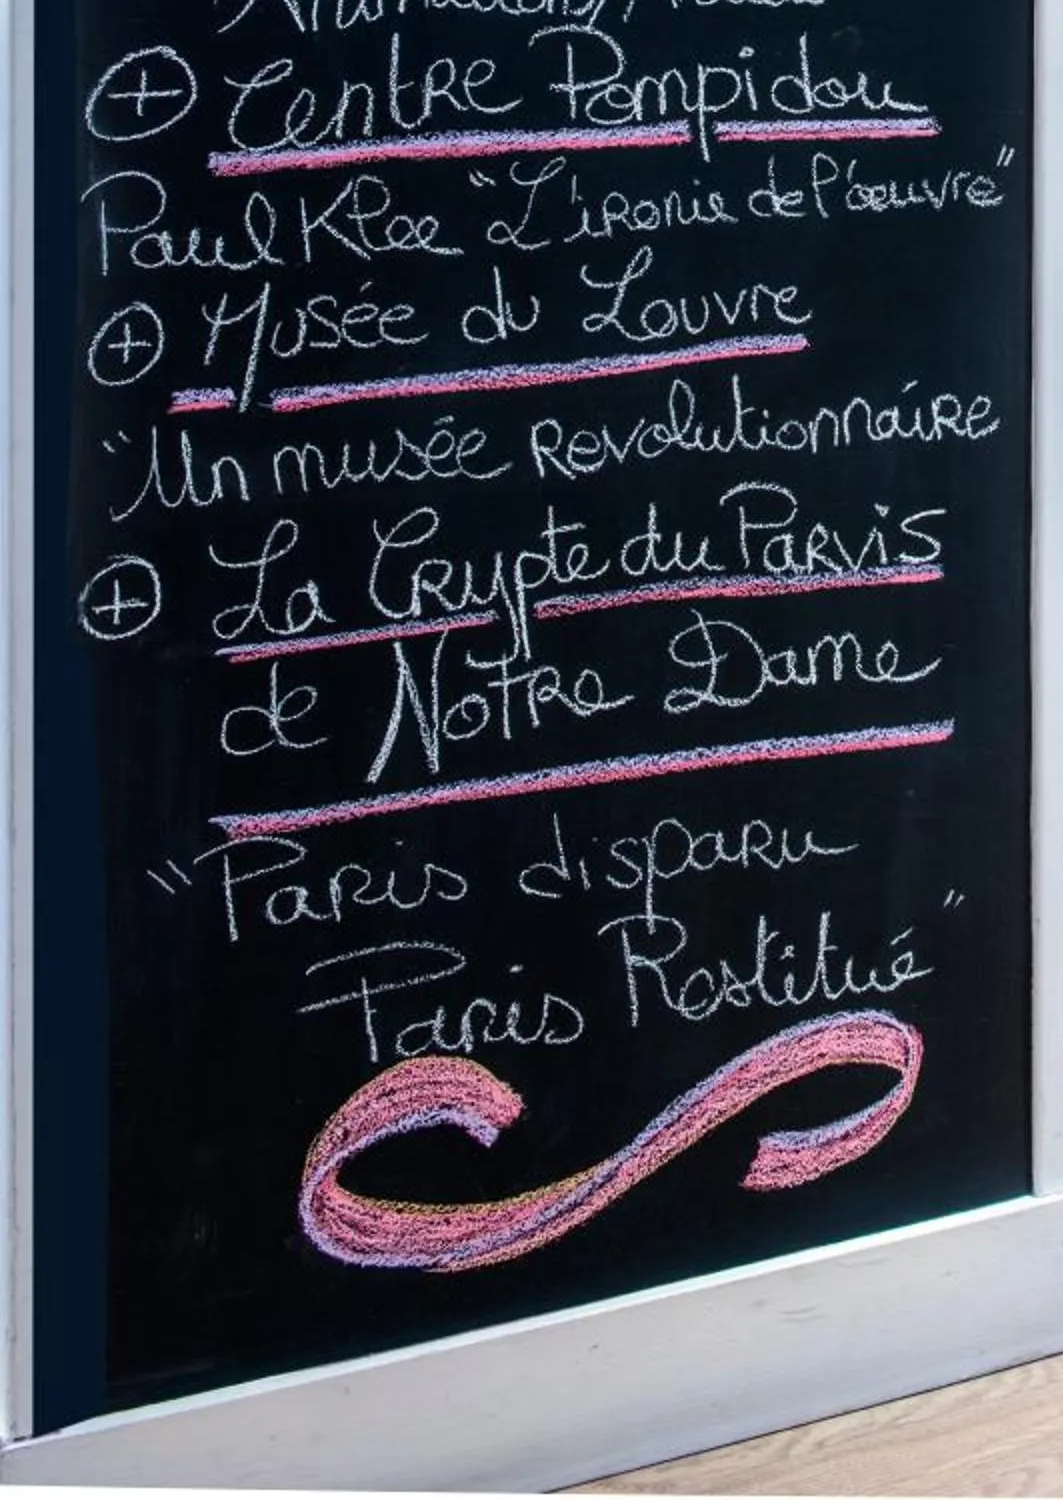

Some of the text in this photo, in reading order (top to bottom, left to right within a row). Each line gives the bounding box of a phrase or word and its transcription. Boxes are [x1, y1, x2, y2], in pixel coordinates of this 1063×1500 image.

[224, 23, 928, 161] Centre Pompidou
[81, 170, 284, 277] Paul
[299, 174, 464, 263] Klee
[748, 156, 806, 217] de
[201, 250, 813, 412] Musée du Louvre
[272, 415, 514, 494] musée
[208, 518, 336, 640] La
[368, 505, 609, 668] Crypte
[621, 502, 723, 573] du
[220, 661, 327, 755] de
[664, 611, 942, 713] Dame
[518, 813, 859, 933] disparu
[296, 940, 585, 1063] Paris
